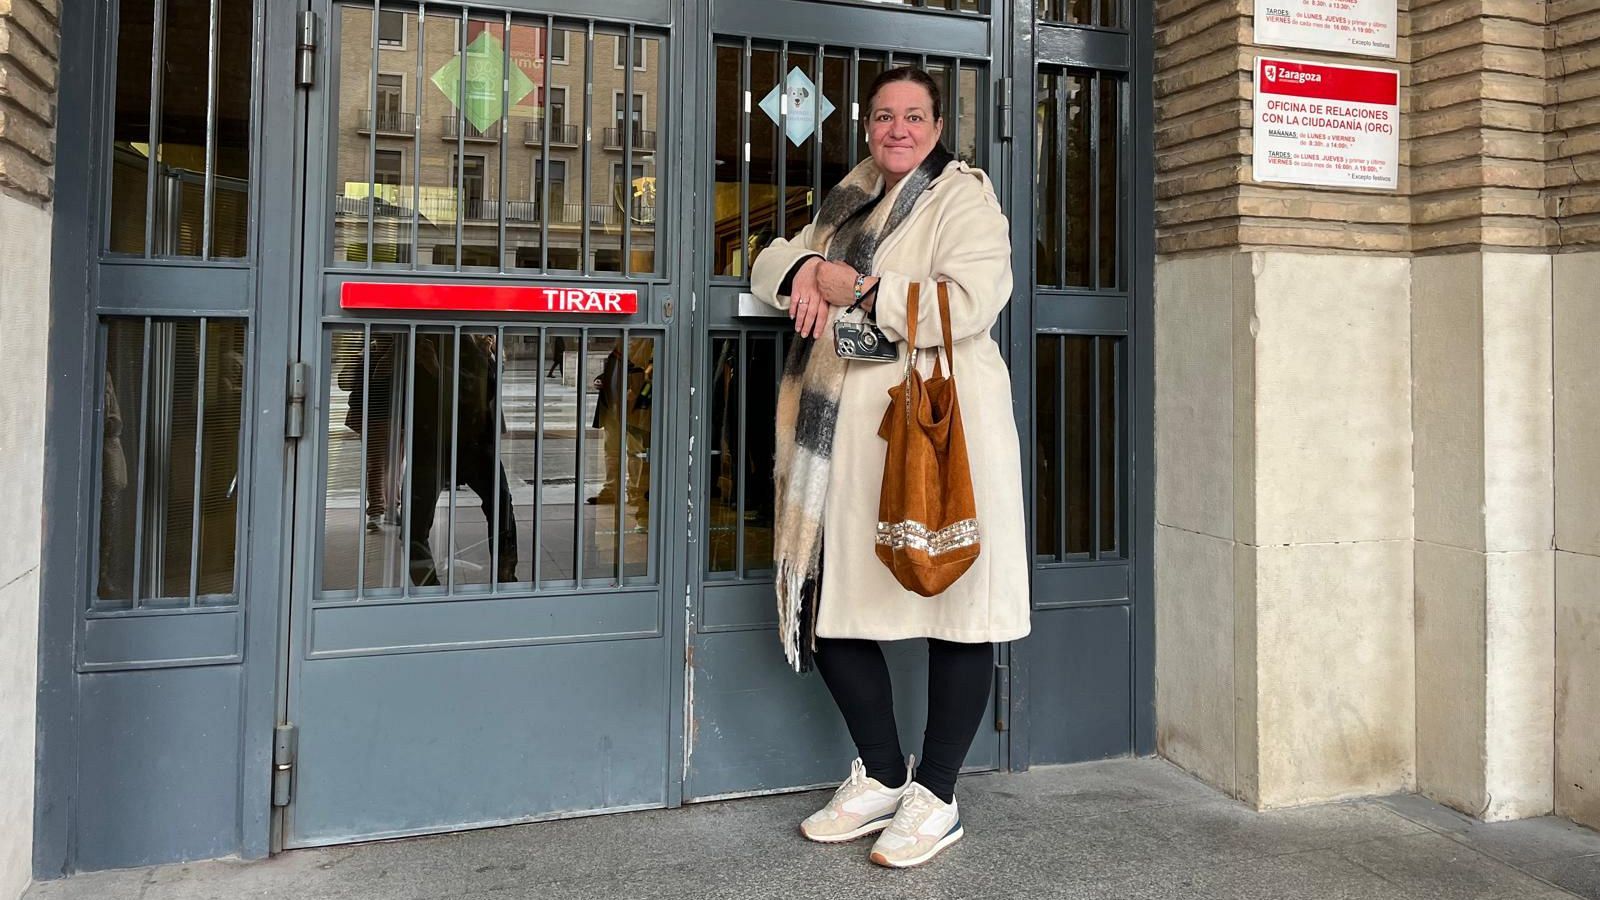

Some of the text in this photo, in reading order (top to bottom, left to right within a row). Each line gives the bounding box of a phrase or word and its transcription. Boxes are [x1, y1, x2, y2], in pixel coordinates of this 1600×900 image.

[1266, 16, 1291, 24] VIERNES
[1325, 16, 1346, 24] JUEVES
[1278, 68, 1321, 83] Zaragoza
[1267, 100, 1388, 120] OFICINA DE RELACIONES
[1262, 113, 1393, 135] CON LA CIUDADANÍA (ORC)
[1268, 158, 1292, 166] VIERNES
[1321, 155, 1344, 163] JUEVES
[542, 289, 622, 311] TIRAR
